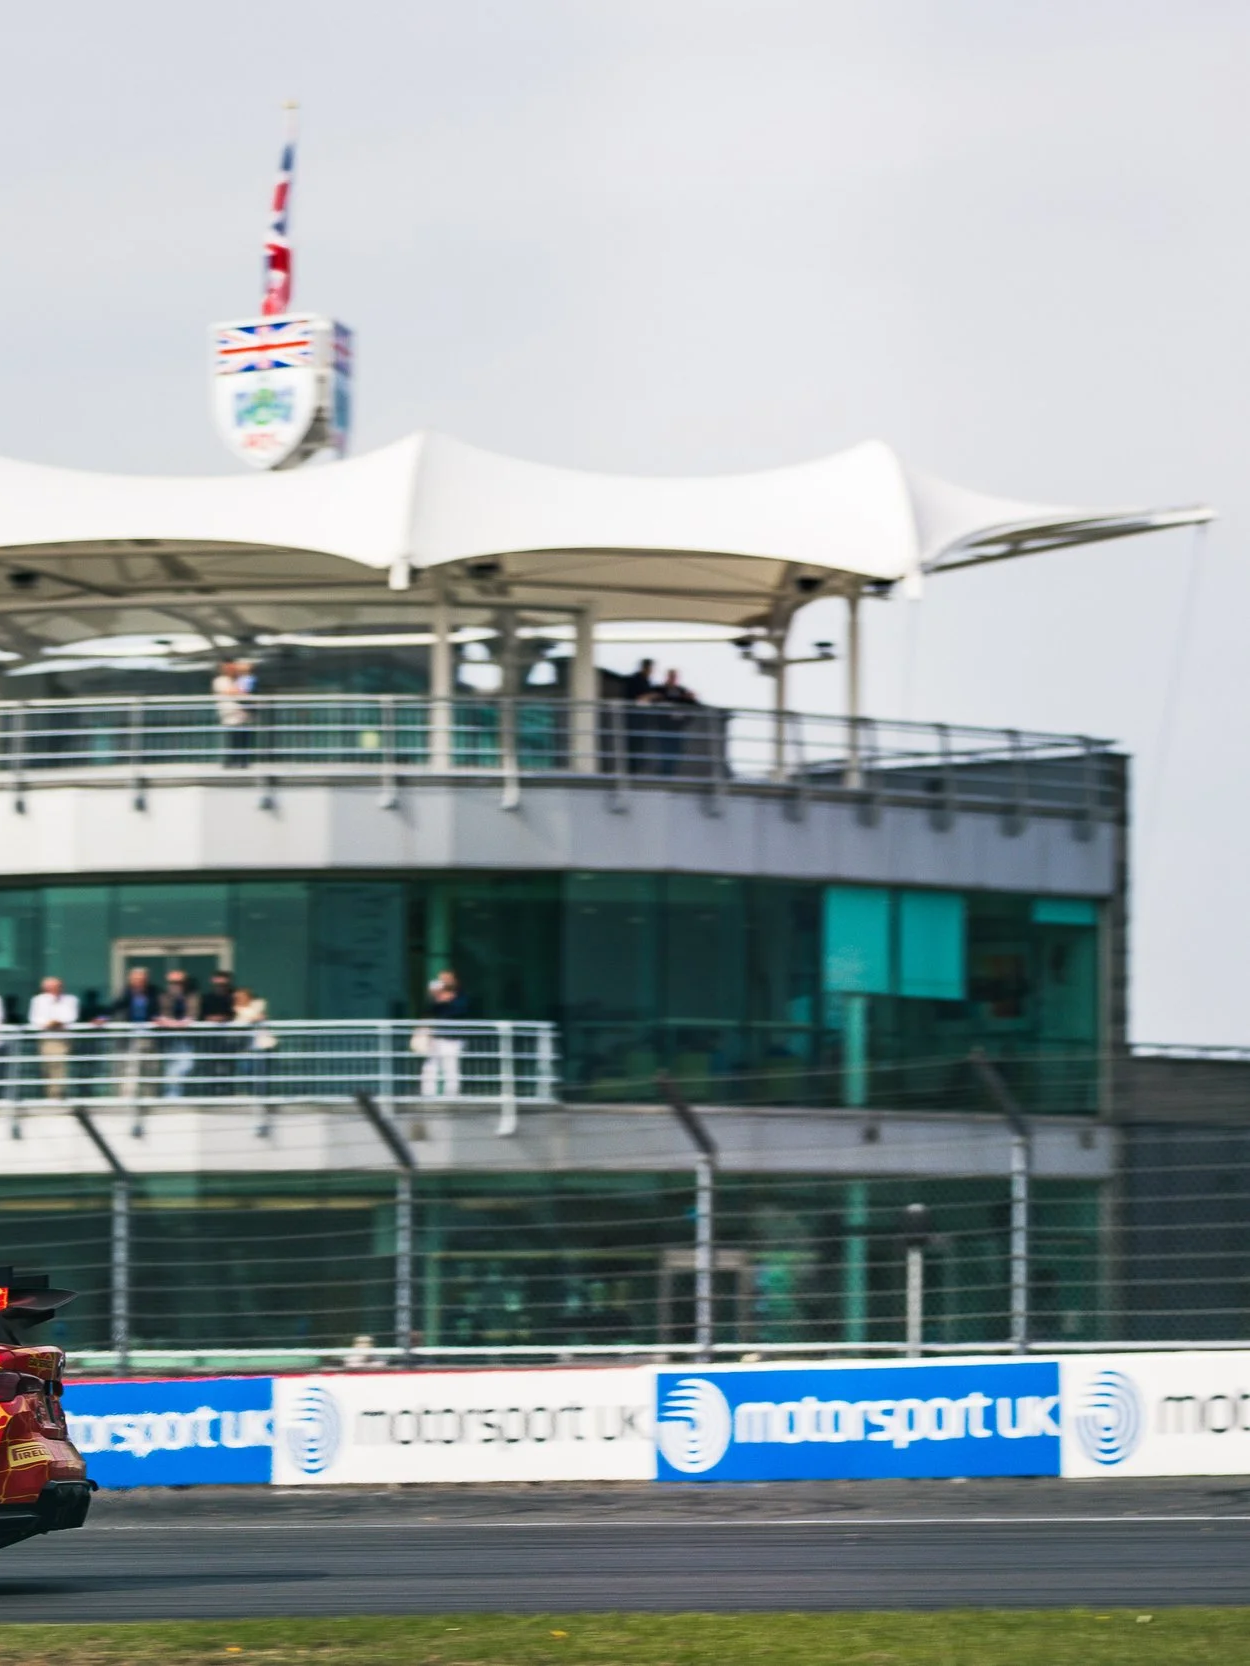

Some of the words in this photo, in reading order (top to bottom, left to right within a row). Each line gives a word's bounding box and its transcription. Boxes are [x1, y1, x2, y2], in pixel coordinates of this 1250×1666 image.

[356, 1402, 584, 1450] motorsport
[734, 1391, 993, 1448] motorsport
[996, 1396, 1060, 1438] UK
[12, 1444, 50, 1461] PIREL
